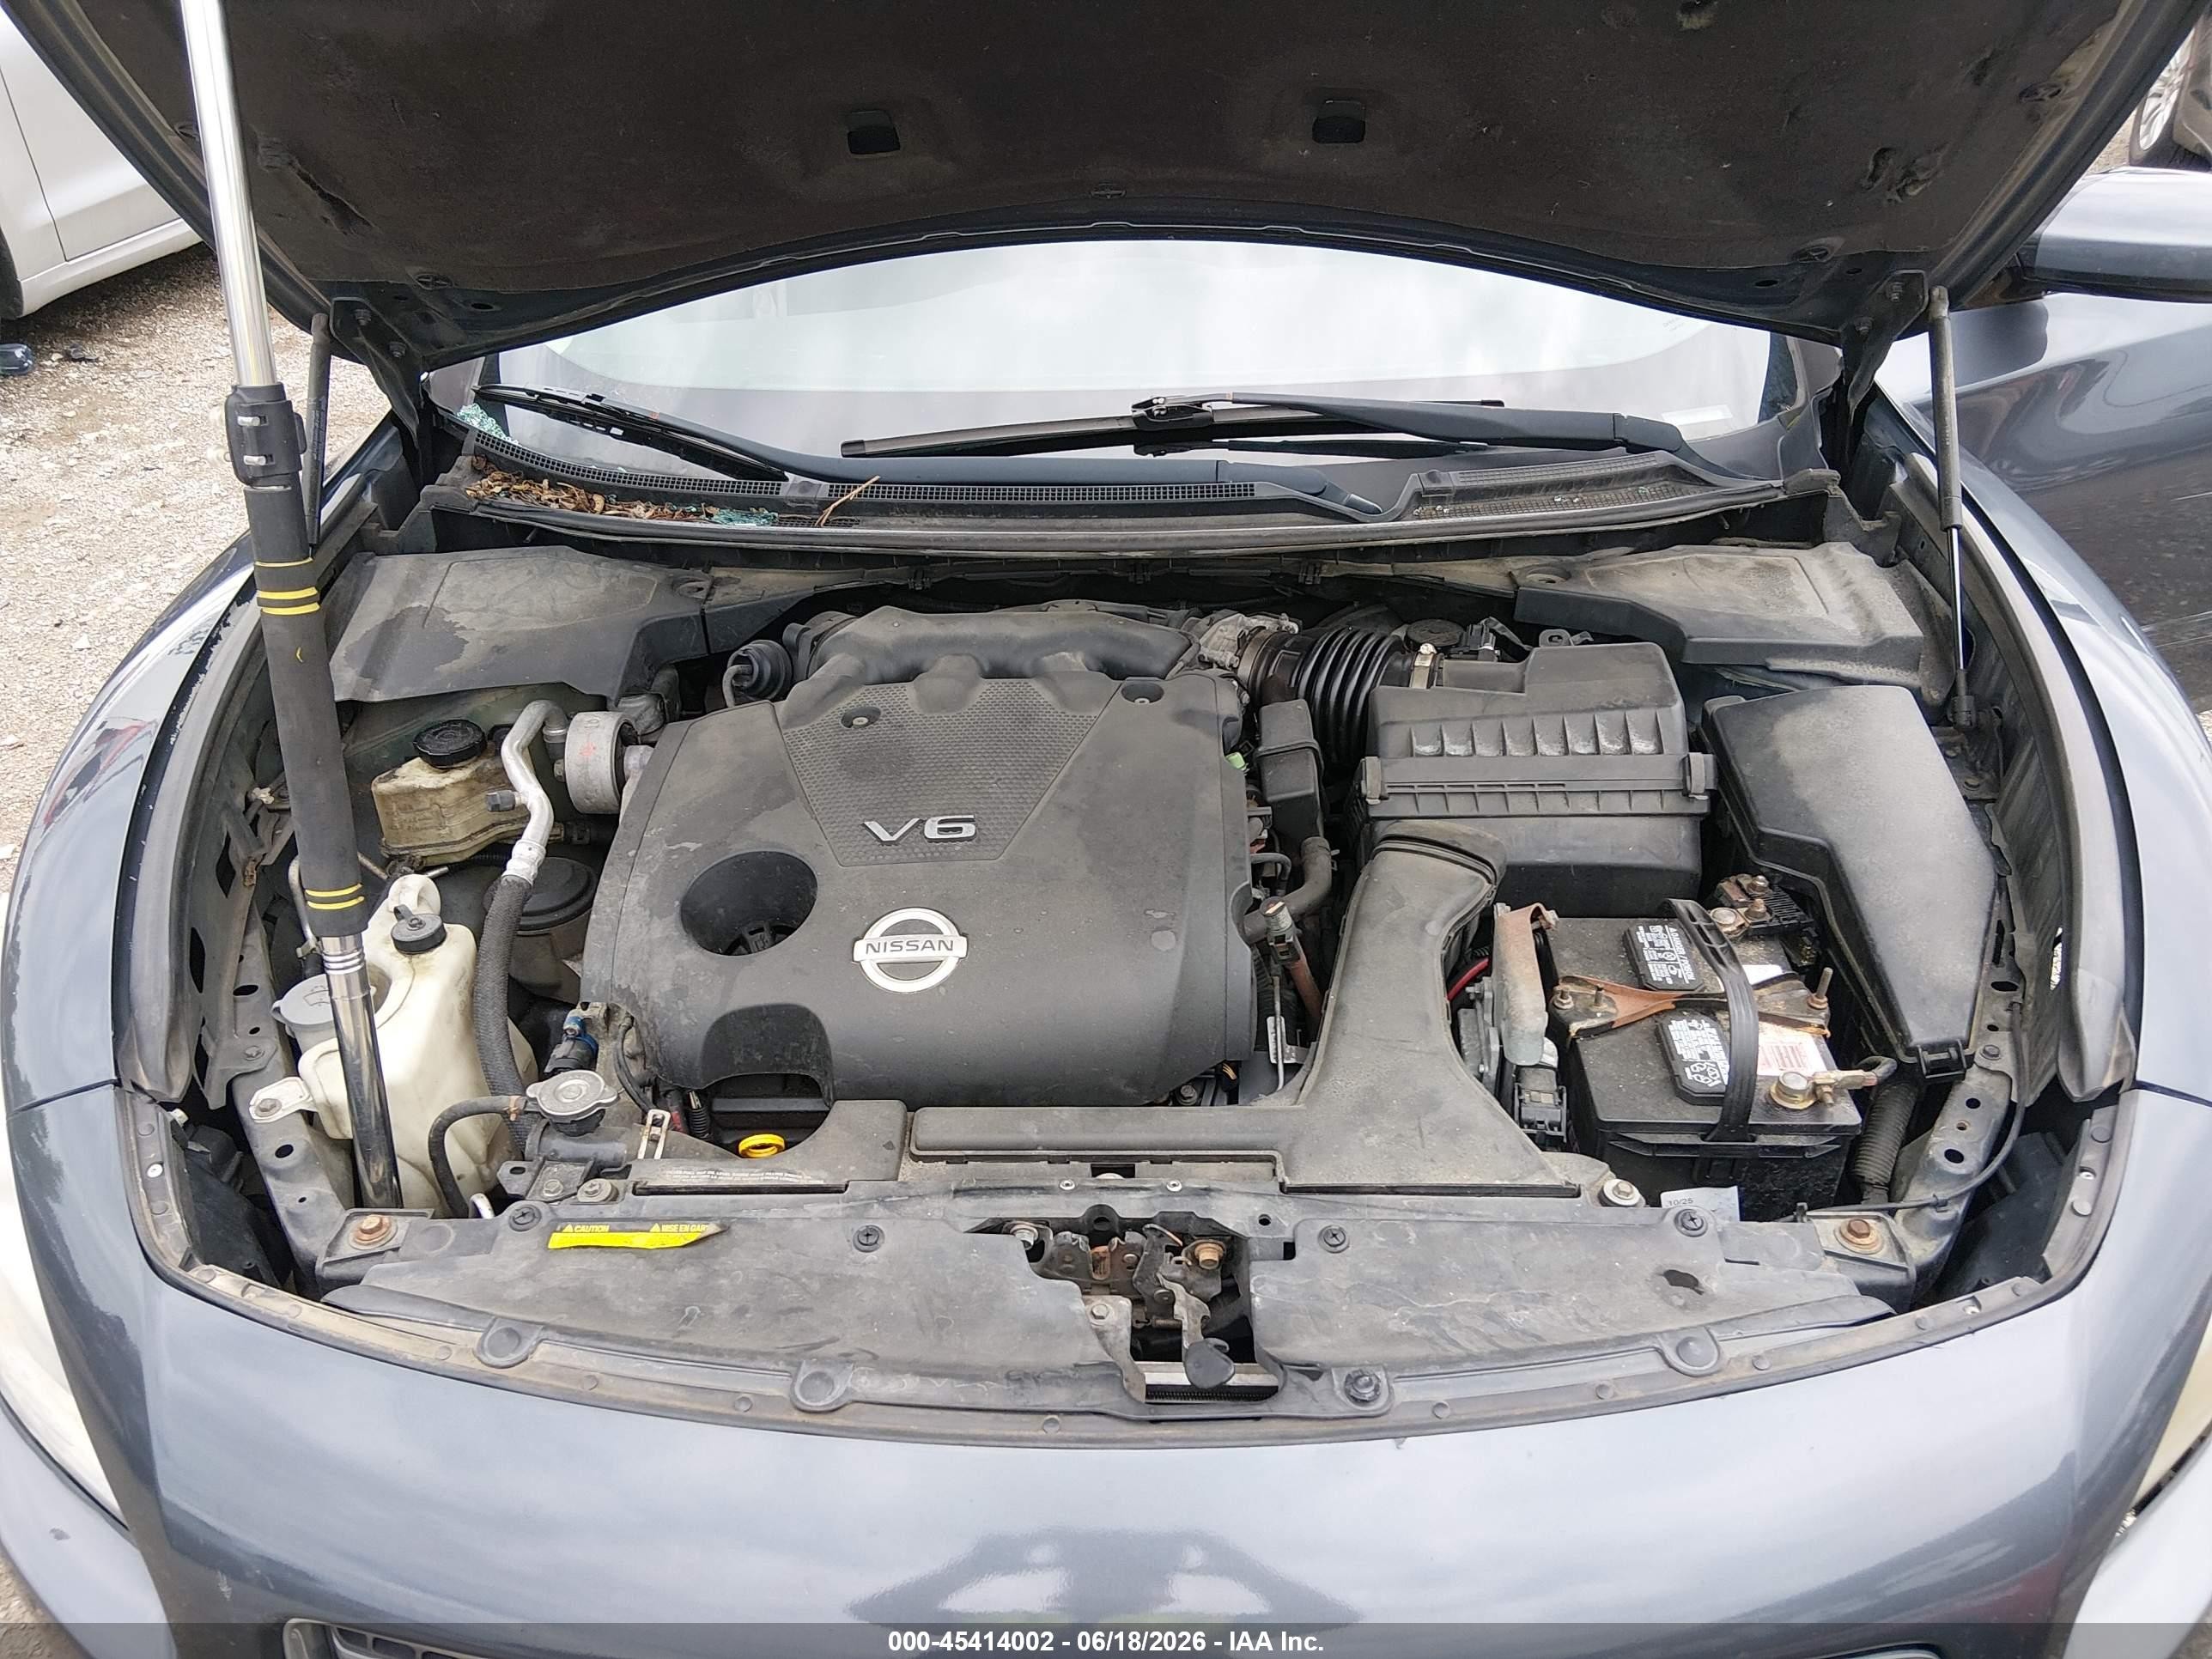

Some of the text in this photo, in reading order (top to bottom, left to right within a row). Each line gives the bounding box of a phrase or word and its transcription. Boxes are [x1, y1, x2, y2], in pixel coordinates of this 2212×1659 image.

[863, 814, 976, 844] V6
[865, 939, 955, 956] NISSAN
[1668, 1198, 1694, 1206] 10/25
[574, 1224, 610, 1233] CAUTION
[661, 1224, 679, 1232] MISE
[679, 1224, 690, 1232] EN
